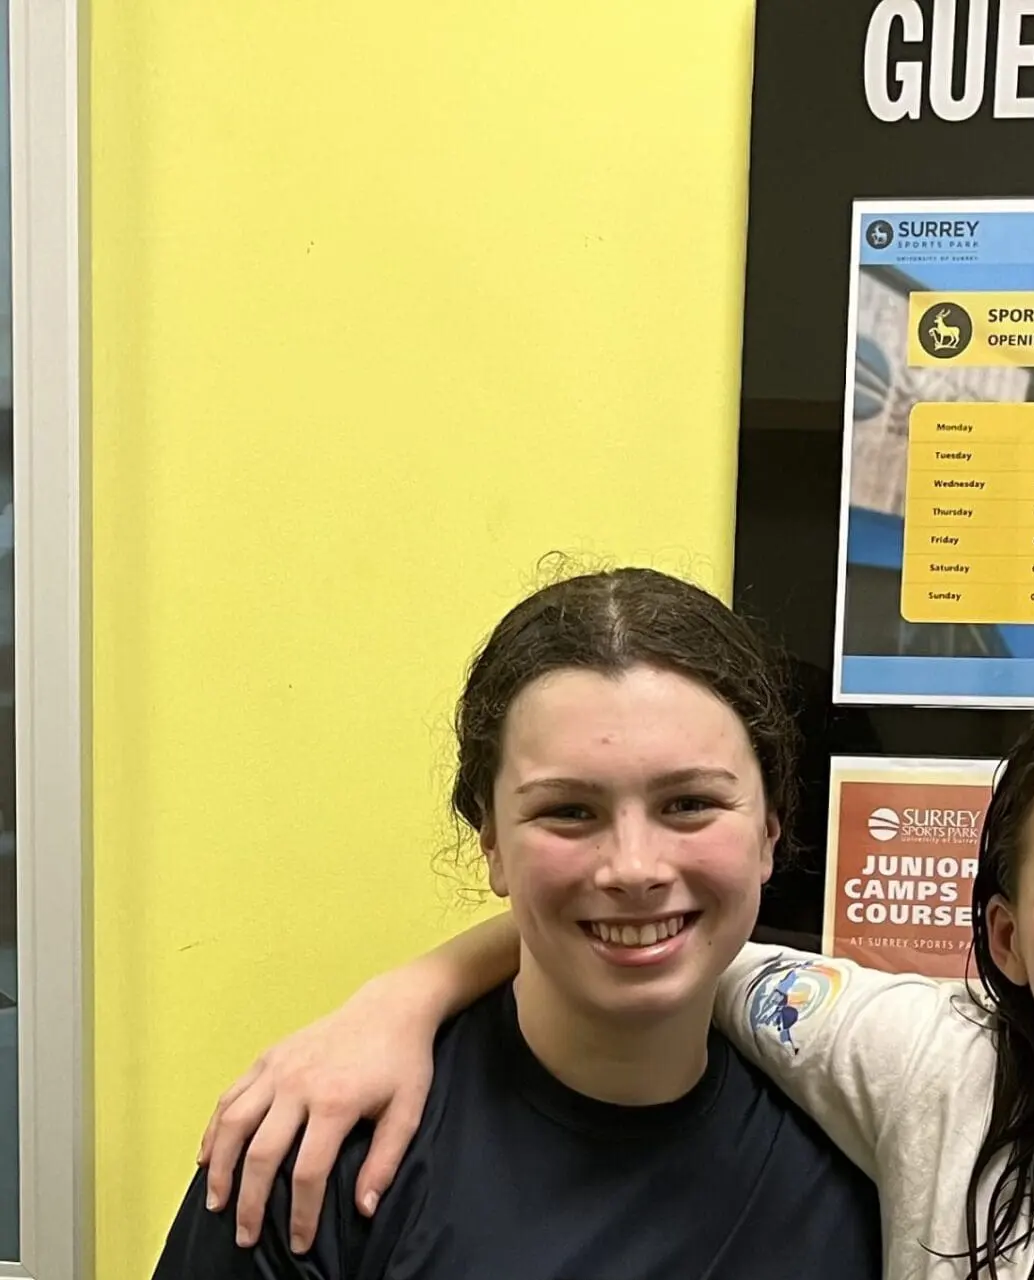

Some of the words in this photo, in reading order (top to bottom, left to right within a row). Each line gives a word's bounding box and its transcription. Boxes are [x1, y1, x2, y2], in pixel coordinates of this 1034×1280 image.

[899, 221, 979, 237] SURREY
[937, 424, 972, 433] Monday
[936, 452, 971, 461] Tuesday
[934, 480, 985, 489] Wednesday
[933, 508, 972, 517] Thursday
[931, 536, 959, 545] Friday
[930, 564, 969, 573] Saturday
[929, 592, 961, 601] Sunday
[902, 809, 981, 827] SURREY
[902, 826, 945, 837] SPORTS
[948, 827, 978, 838] PARK
[862, 856, 978, 878] JUNIOR
[844, 879, 958, 901] CAMPS
[850, 937, 863, 945] AT
[868, 938, 907, 948] SURREY
[914, 940, 953, 949] SPORTS
